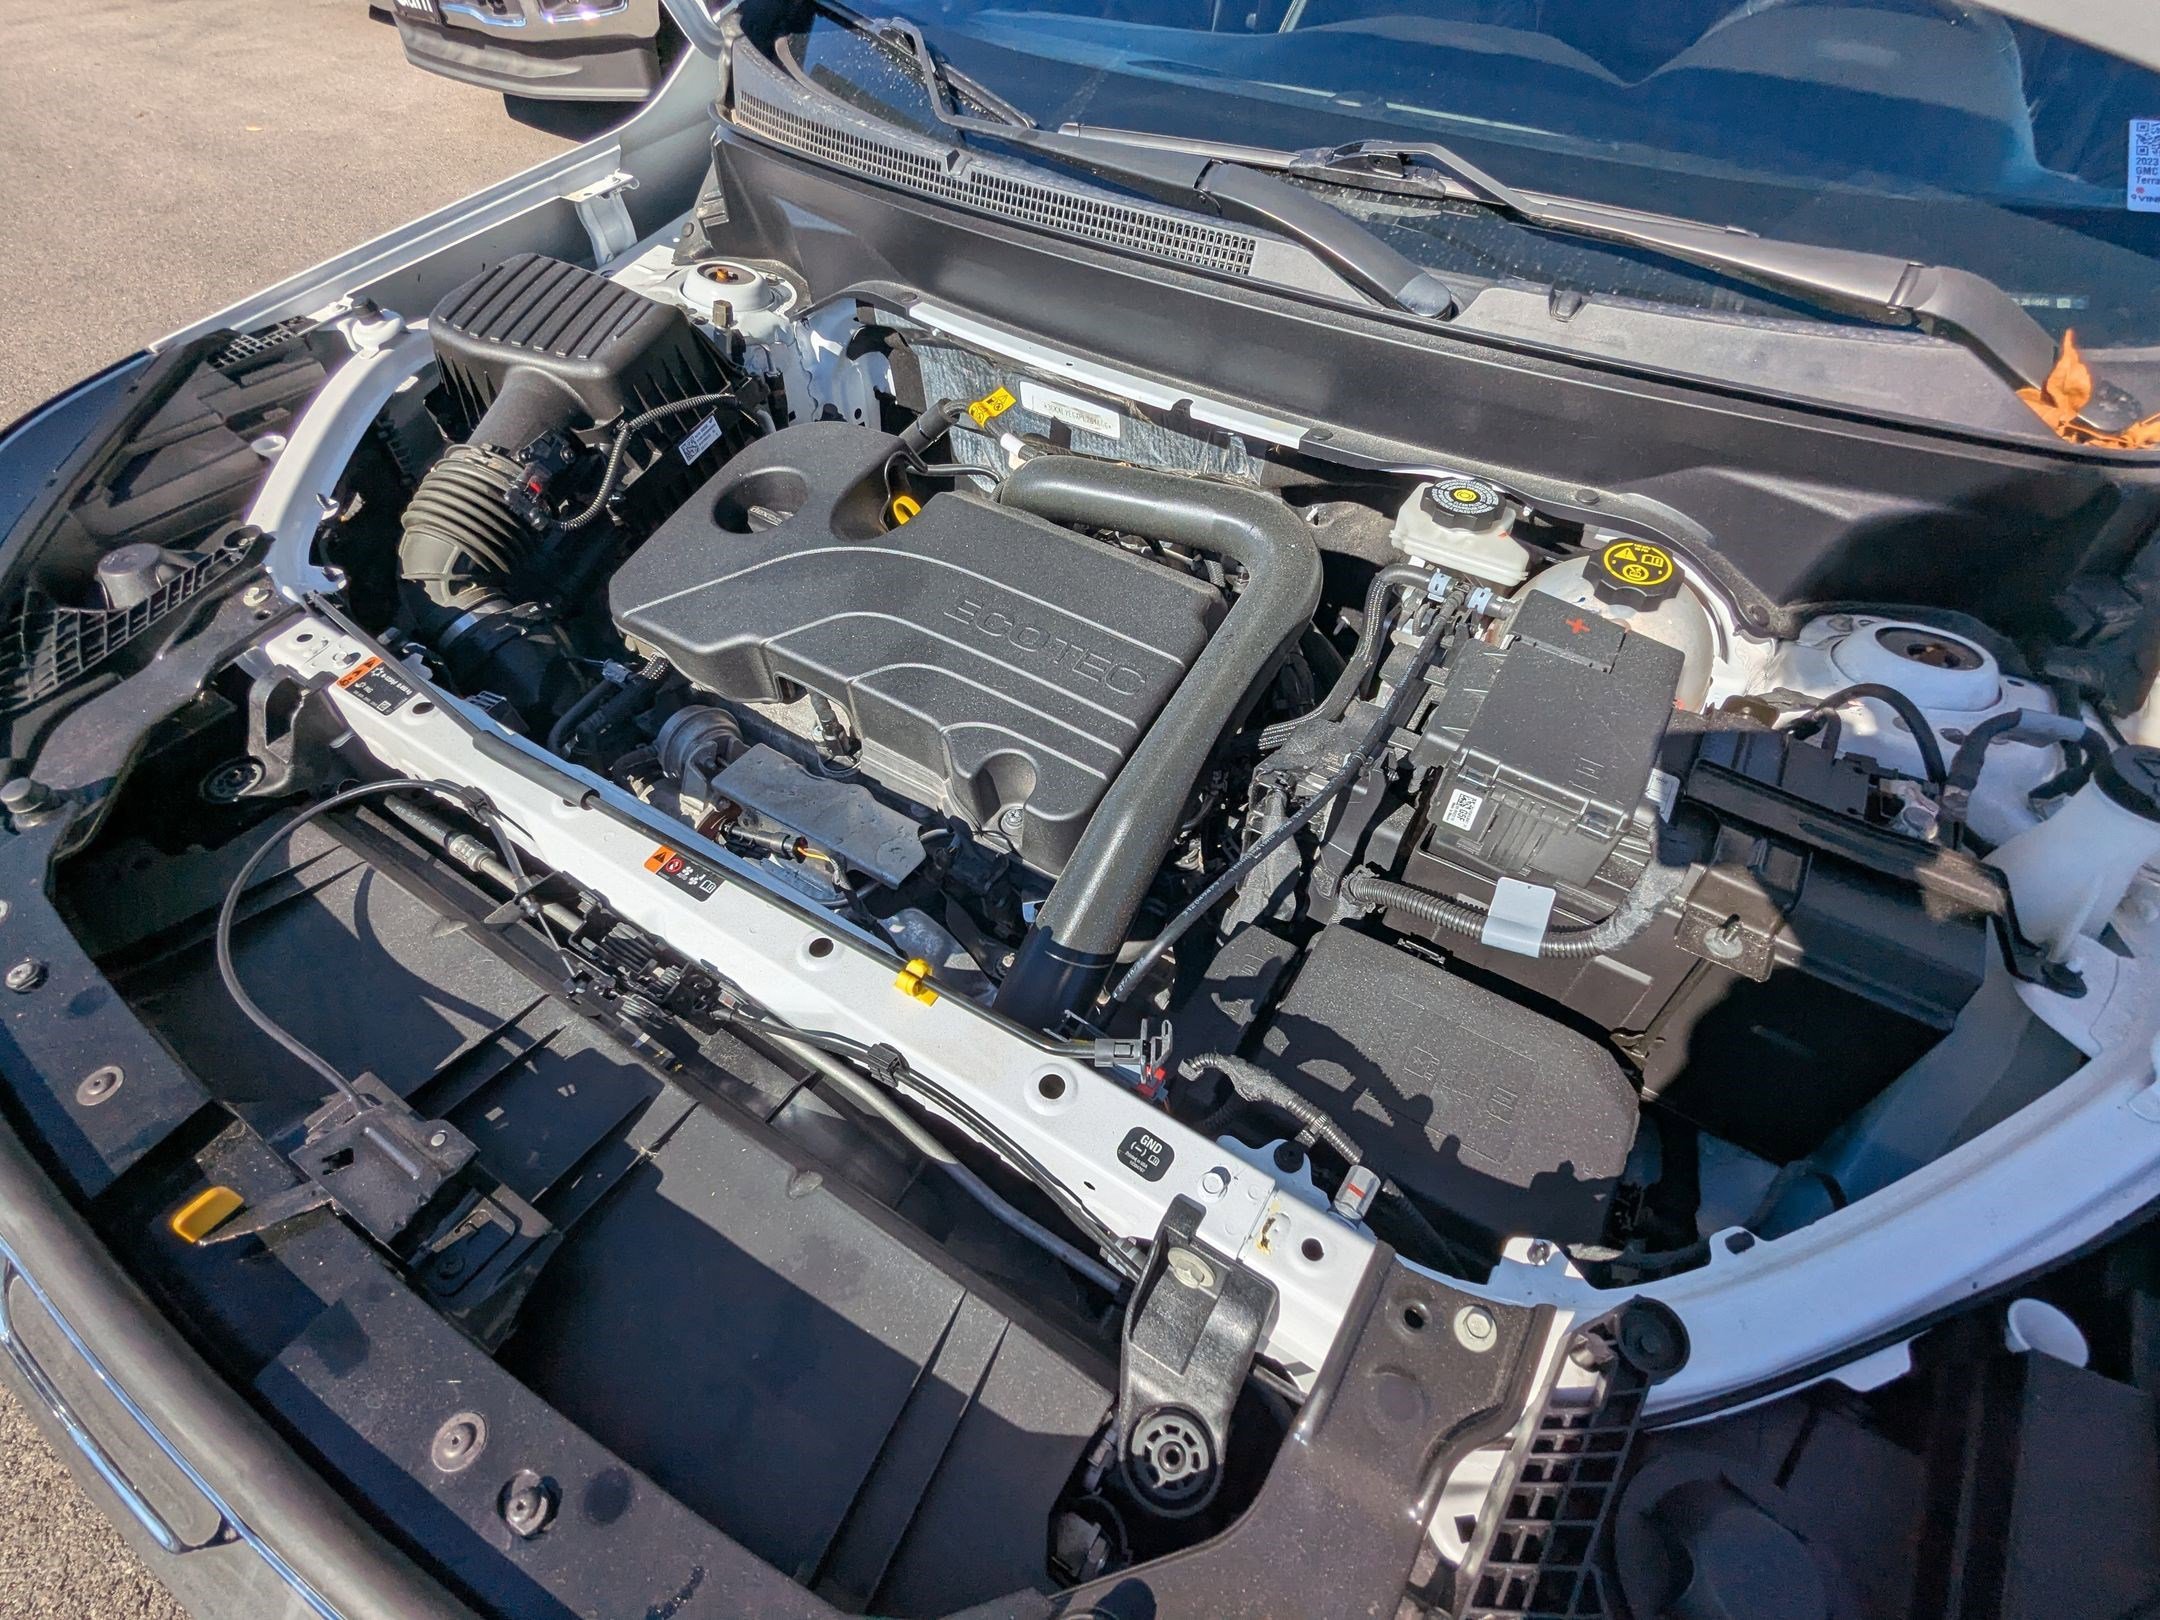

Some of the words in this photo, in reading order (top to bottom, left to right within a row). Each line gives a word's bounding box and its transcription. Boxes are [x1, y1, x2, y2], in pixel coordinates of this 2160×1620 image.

[2136, 157, 2159, 166] 2023
[2136, 166, 2158, 176] GMC
[943, 600, 1147, 695] ECOTEC
[1140, 1134, 1163, 1154] GND
